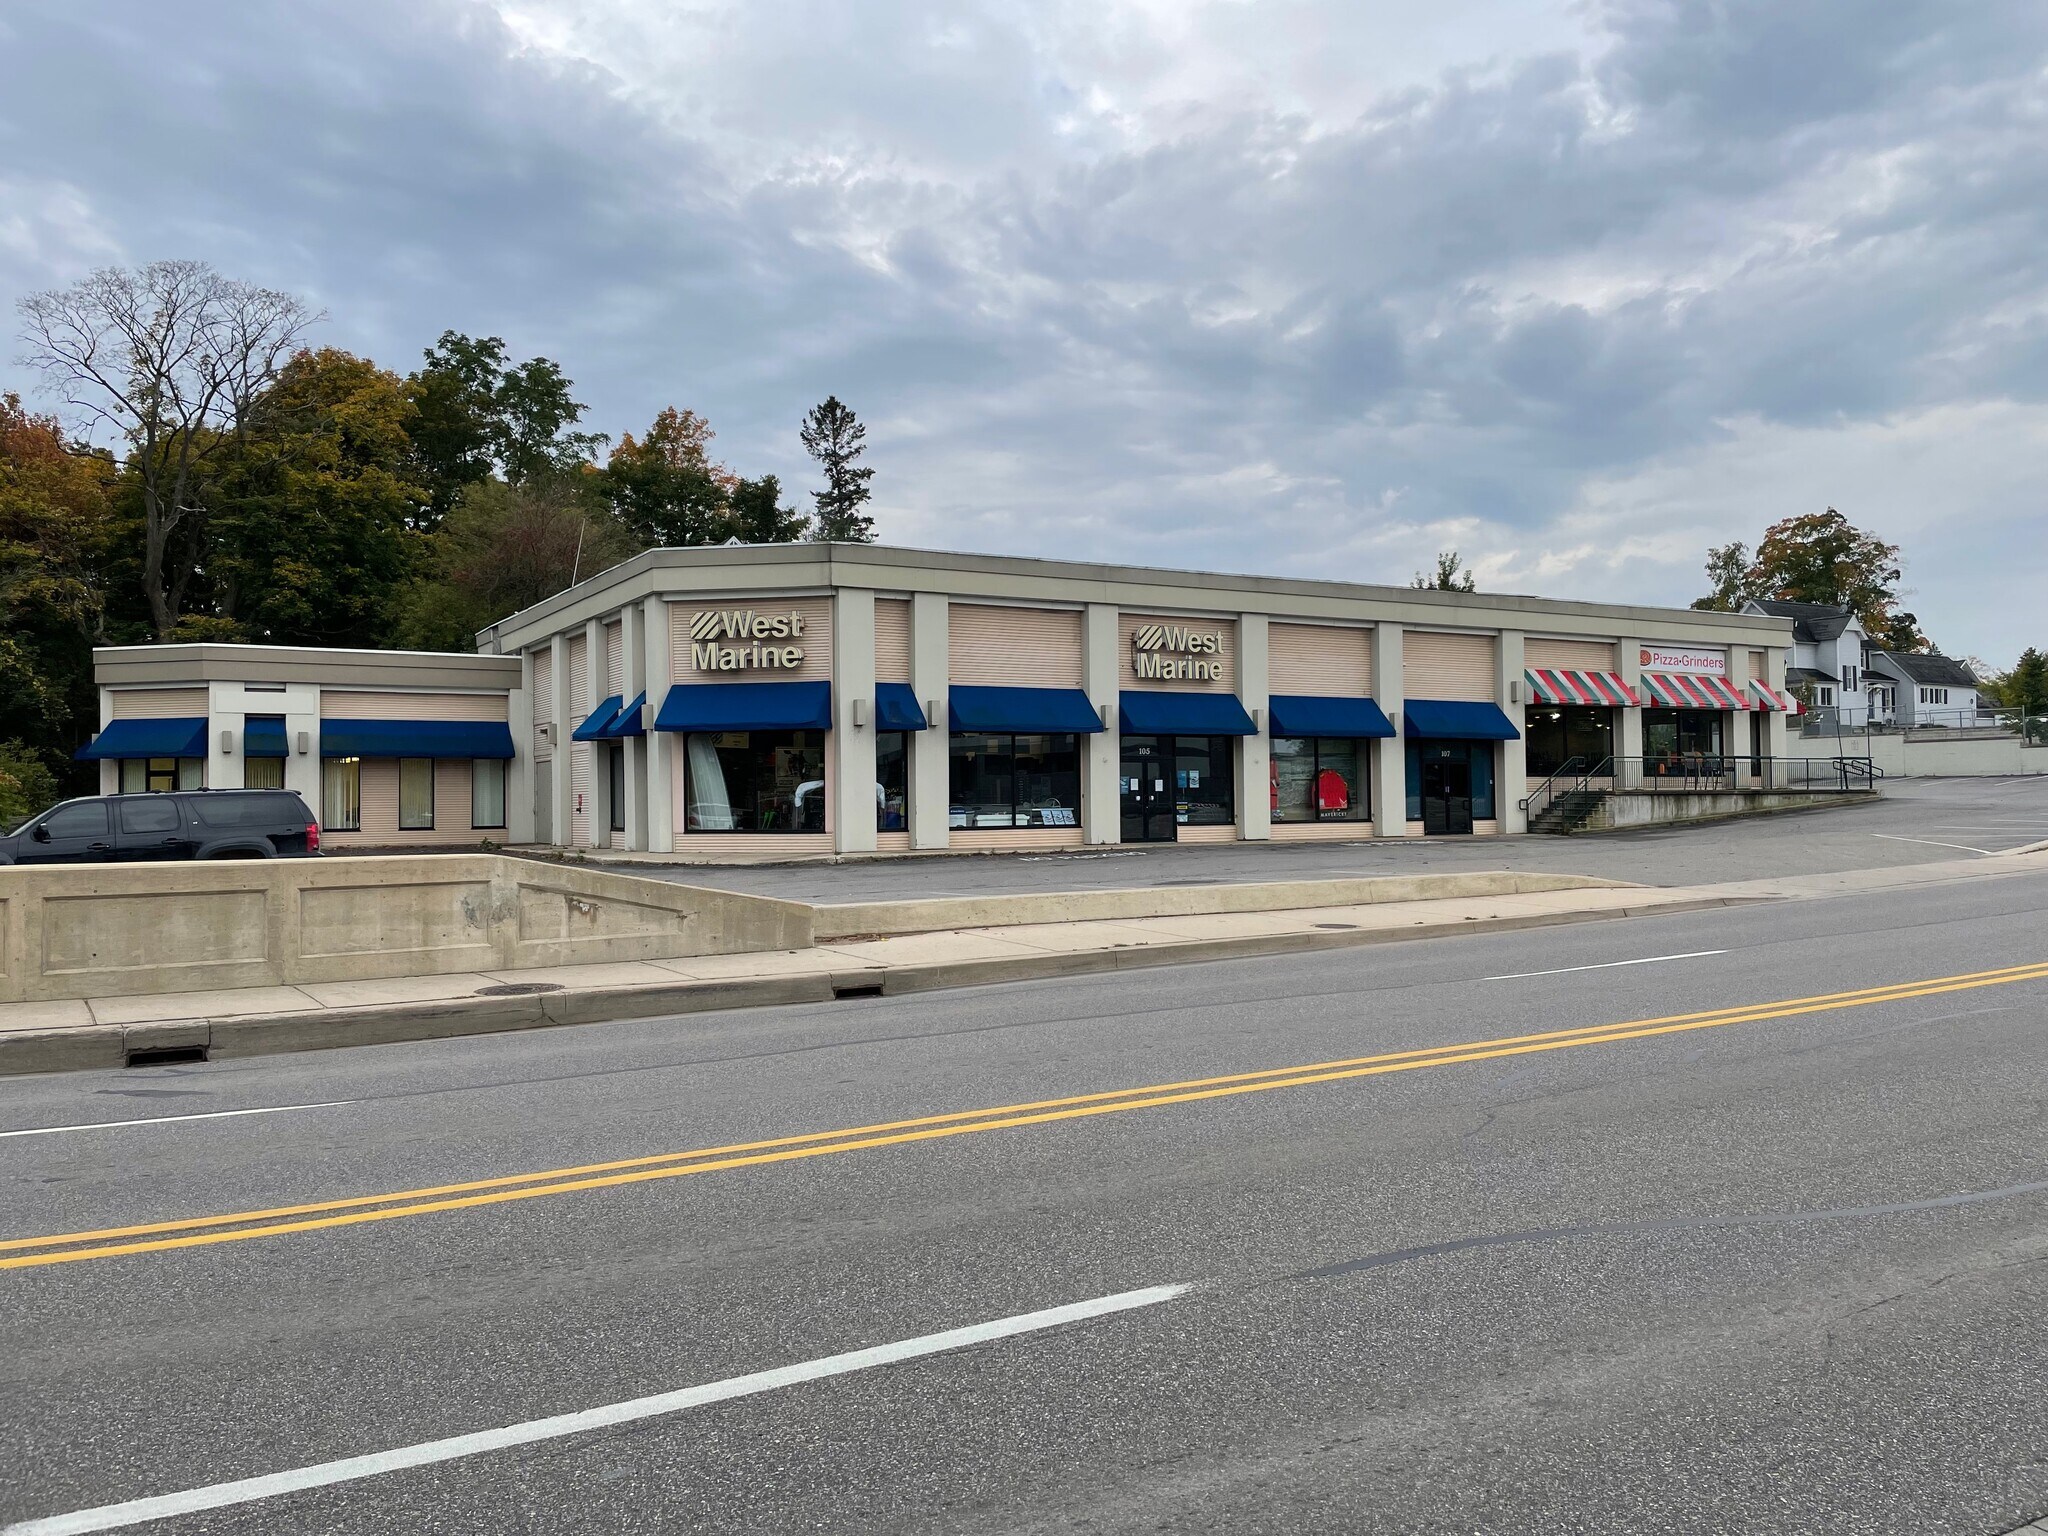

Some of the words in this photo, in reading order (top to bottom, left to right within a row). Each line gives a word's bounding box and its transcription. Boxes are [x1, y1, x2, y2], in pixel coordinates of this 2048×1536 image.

[721, 609, 803, 639] West
[1163, 625, 1224, 654] West
[691, 640, 803, 671] Marine
[1137, 652, 1223, 681] Marine
[1138, 747, 1151, 756] 105
